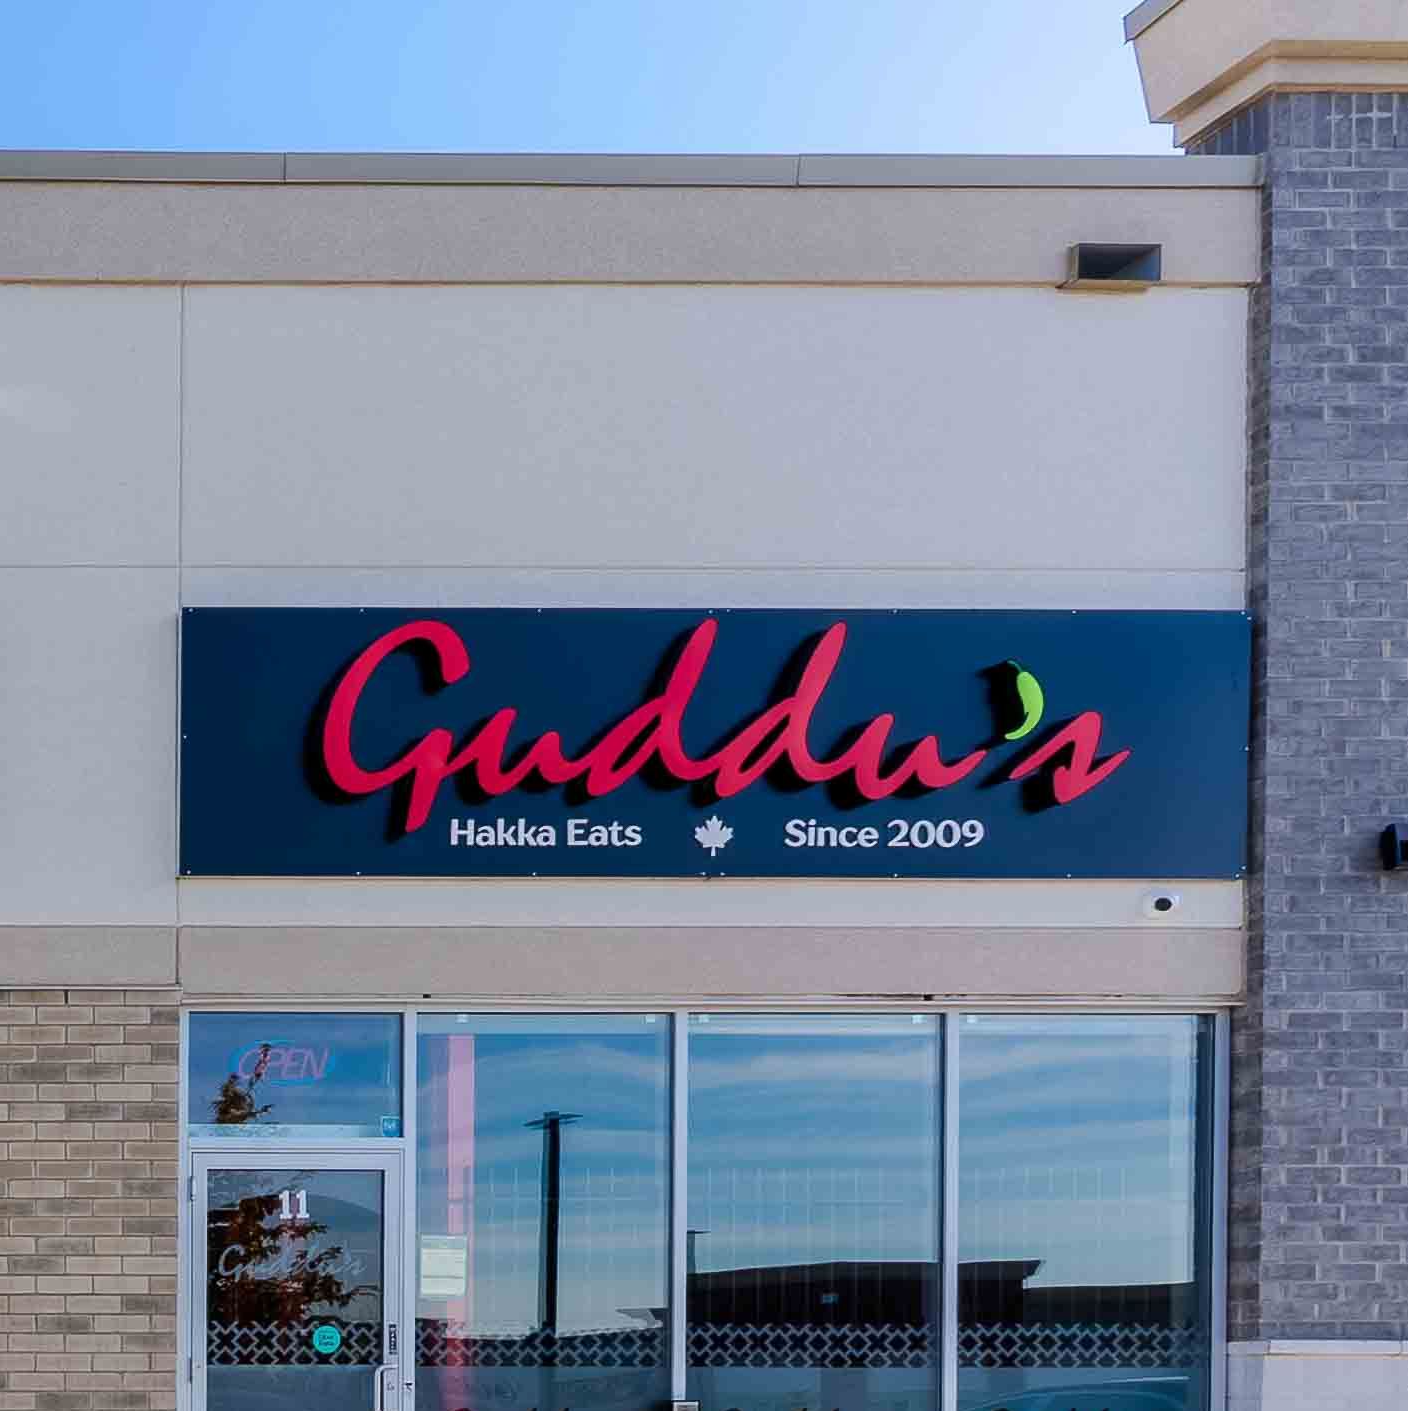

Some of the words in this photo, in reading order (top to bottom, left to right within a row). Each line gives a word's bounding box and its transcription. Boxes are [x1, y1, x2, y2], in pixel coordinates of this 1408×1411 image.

[320, 617, 1133, 834] Guddu's
[450, 818, 558, 848] Hakka
[565, 818, 642, 848] Eats
[784, 818, 879, 848] Since
[886, 818, 984, 848] 2009
[279, 1190, 310, 1219] 11
